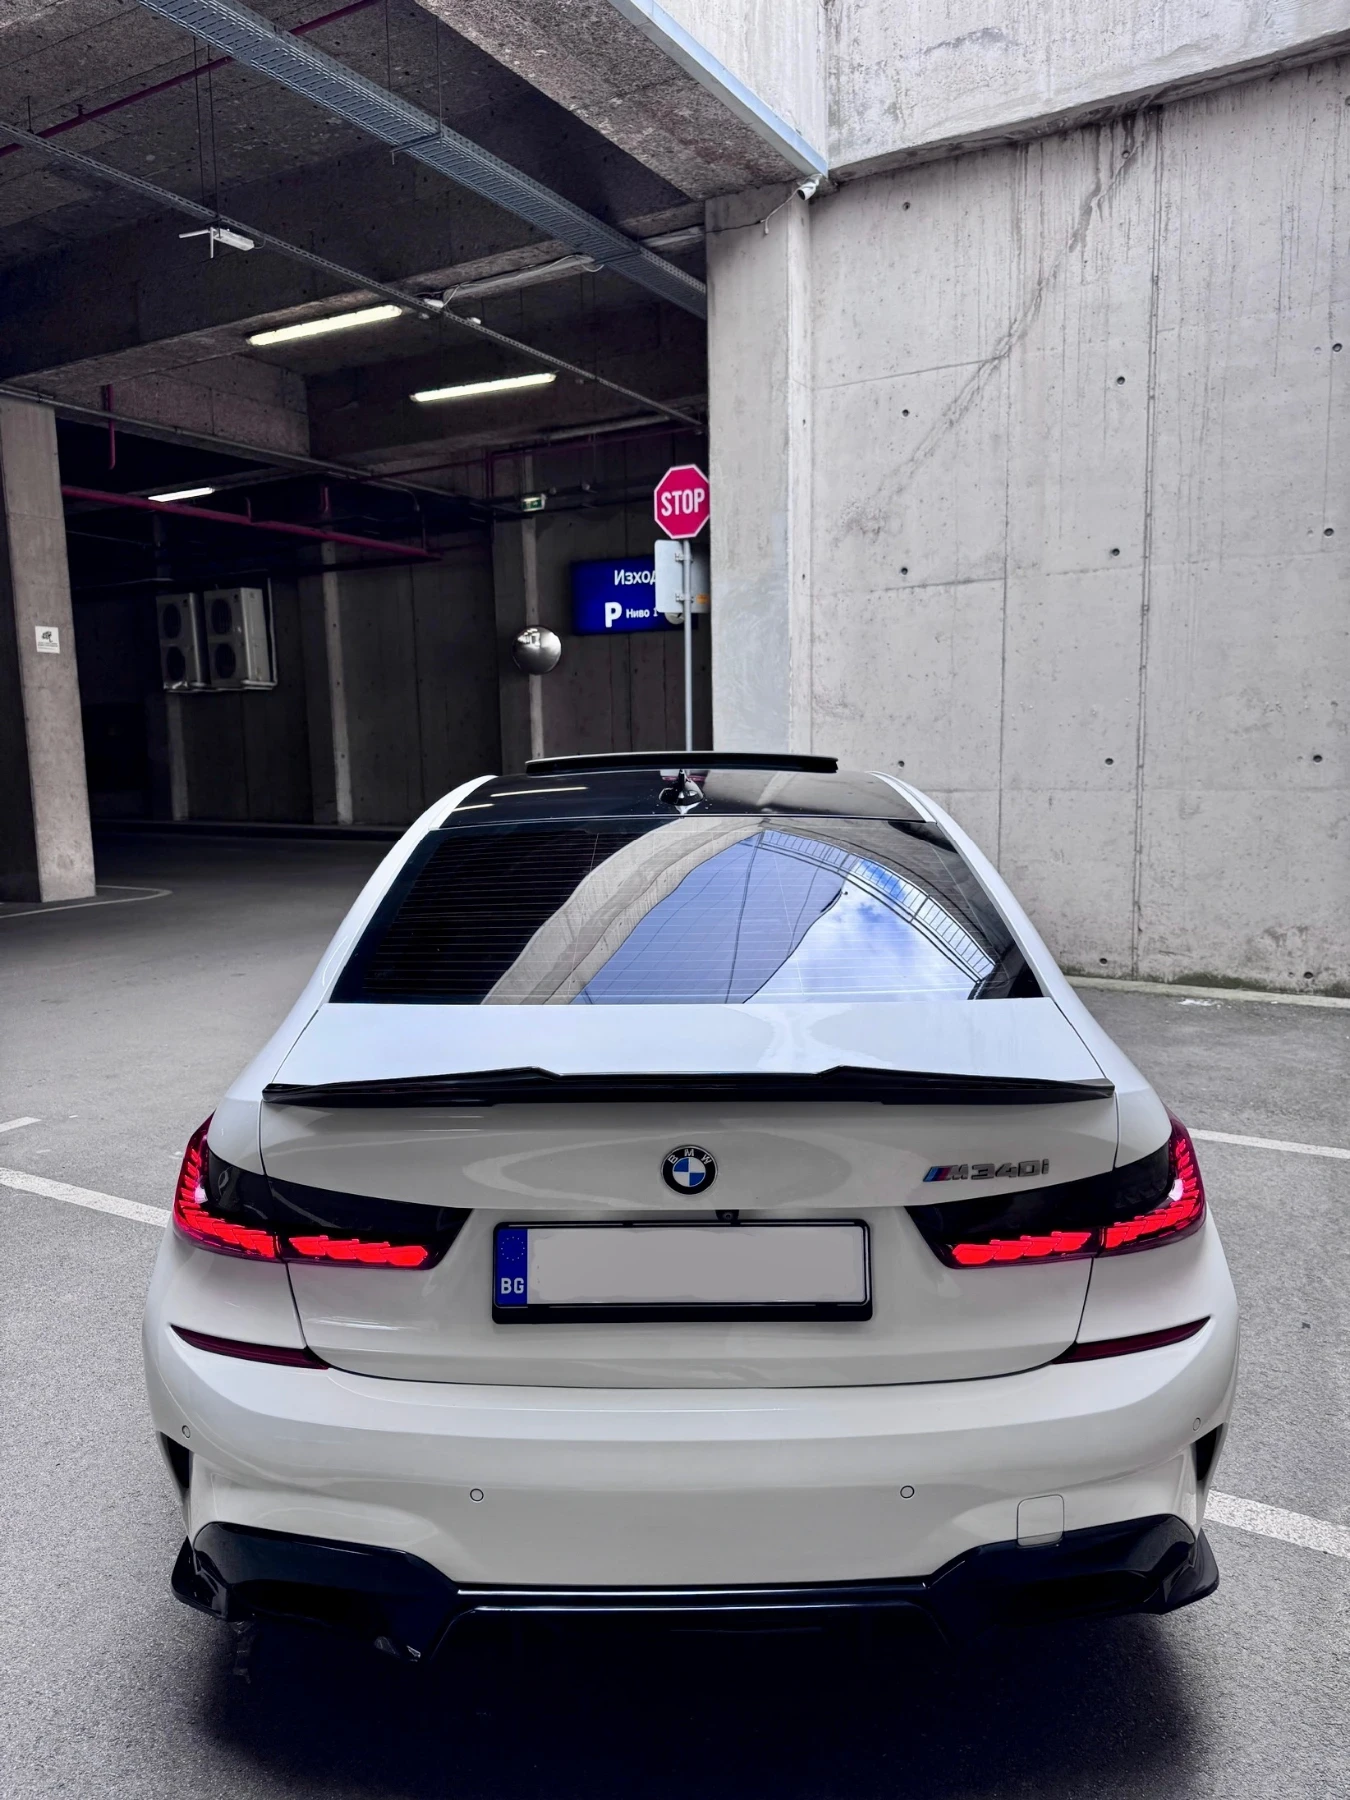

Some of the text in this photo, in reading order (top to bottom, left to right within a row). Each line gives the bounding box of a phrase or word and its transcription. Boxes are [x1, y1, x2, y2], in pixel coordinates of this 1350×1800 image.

[661, 488, 705, 516] STOP
[626, 608, 650, 618] Ниво
[668, 1149, 712, 1165] BMW
[948, 1159, 1049, 1180] M340i
[501, 1277, 524, 1294] BG
